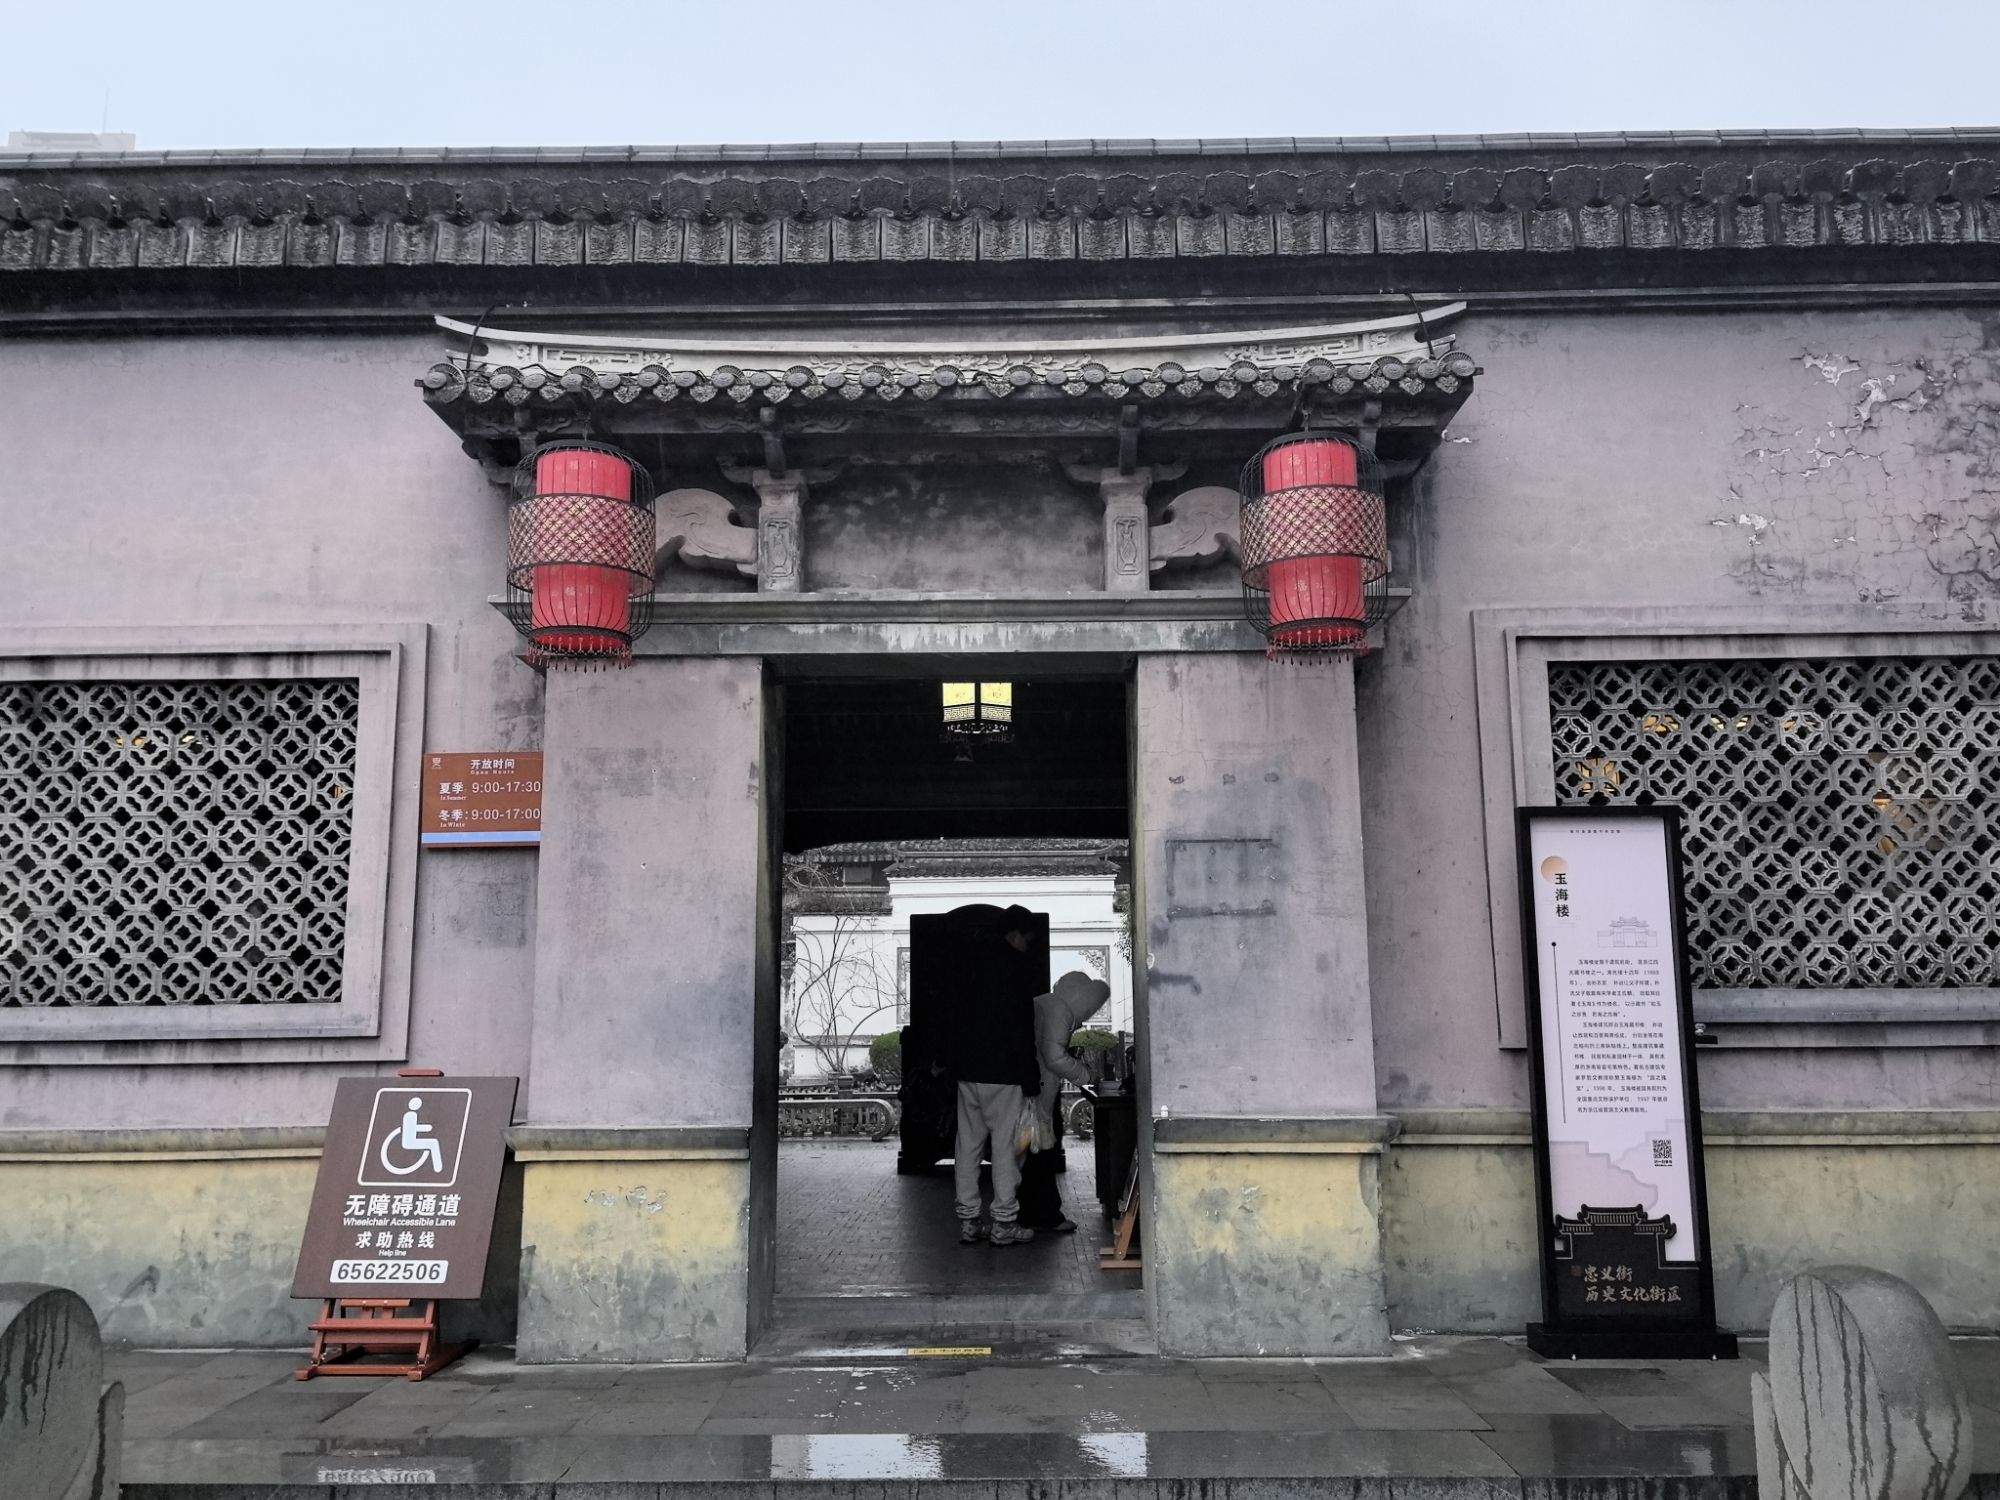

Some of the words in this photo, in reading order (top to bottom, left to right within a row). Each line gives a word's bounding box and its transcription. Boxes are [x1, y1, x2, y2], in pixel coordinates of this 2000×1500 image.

[470, 758, 515, 769] 开放时间
[471, 781, 541, 793] 9:00-17:30
[471, 808, 541, 820] 9:00-17:00
[1554, 873, 1570, 917] 玉海楼
[343, 1194, 462, 1216] 无障碍通道
[343, 1217, 390, 1226] Wheelchair
[390, 1217, 434, 1226] Accessible
[435, 1217, 456, 1226] Lane
[355, 1231, 435, 1249] 求助热线
[378, 1249, 394, 1257] Help
[394, 1249, 407, 1257] line
[337, 1263, 441, 1280] 65622506
[1584, 1264, 1633, 1283] 忠义街
[1585, 1284, 1682, 1303] 历史文化街区
